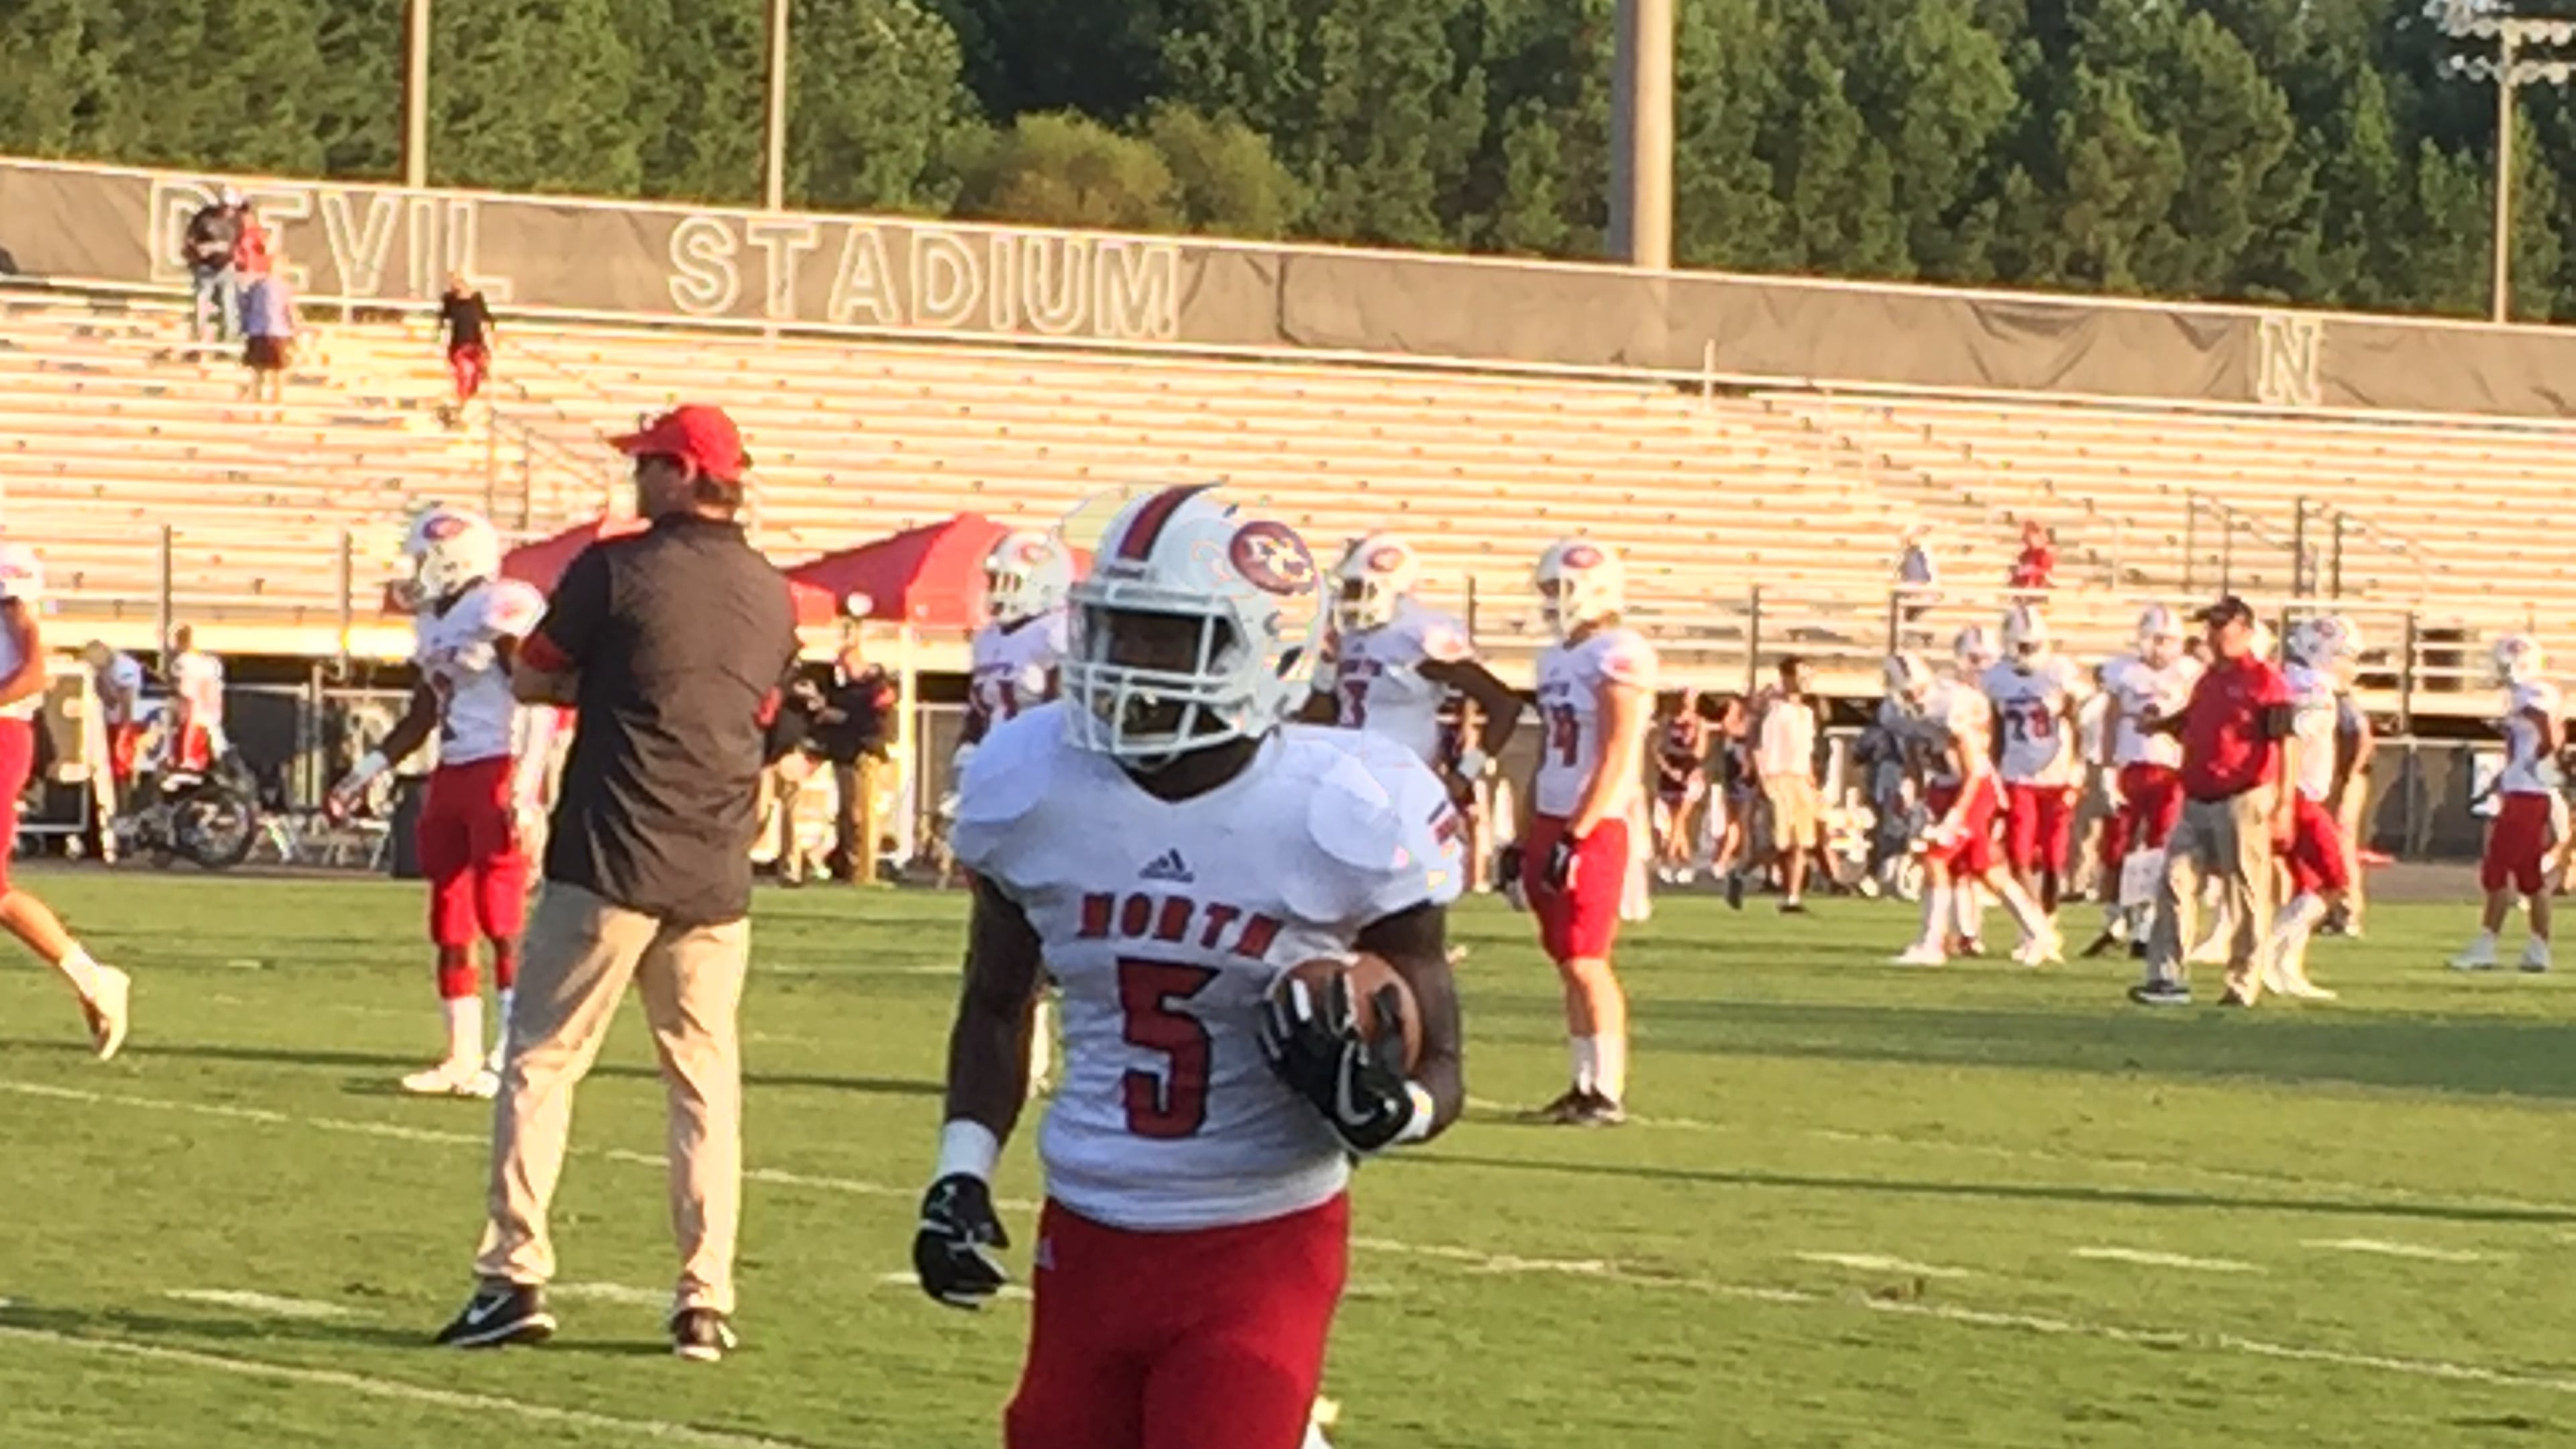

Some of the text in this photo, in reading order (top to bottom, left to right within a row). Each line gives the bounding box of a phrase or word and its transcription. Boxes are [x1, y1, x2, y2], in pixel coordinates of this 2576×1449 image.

[150, 178, 1181, 339] DEVIL STADIUM
[2257, 314, 2322, 406] N
[1075, 892, 1284, 960] NORTH
[1116, 955, 1222, 1139] 5
